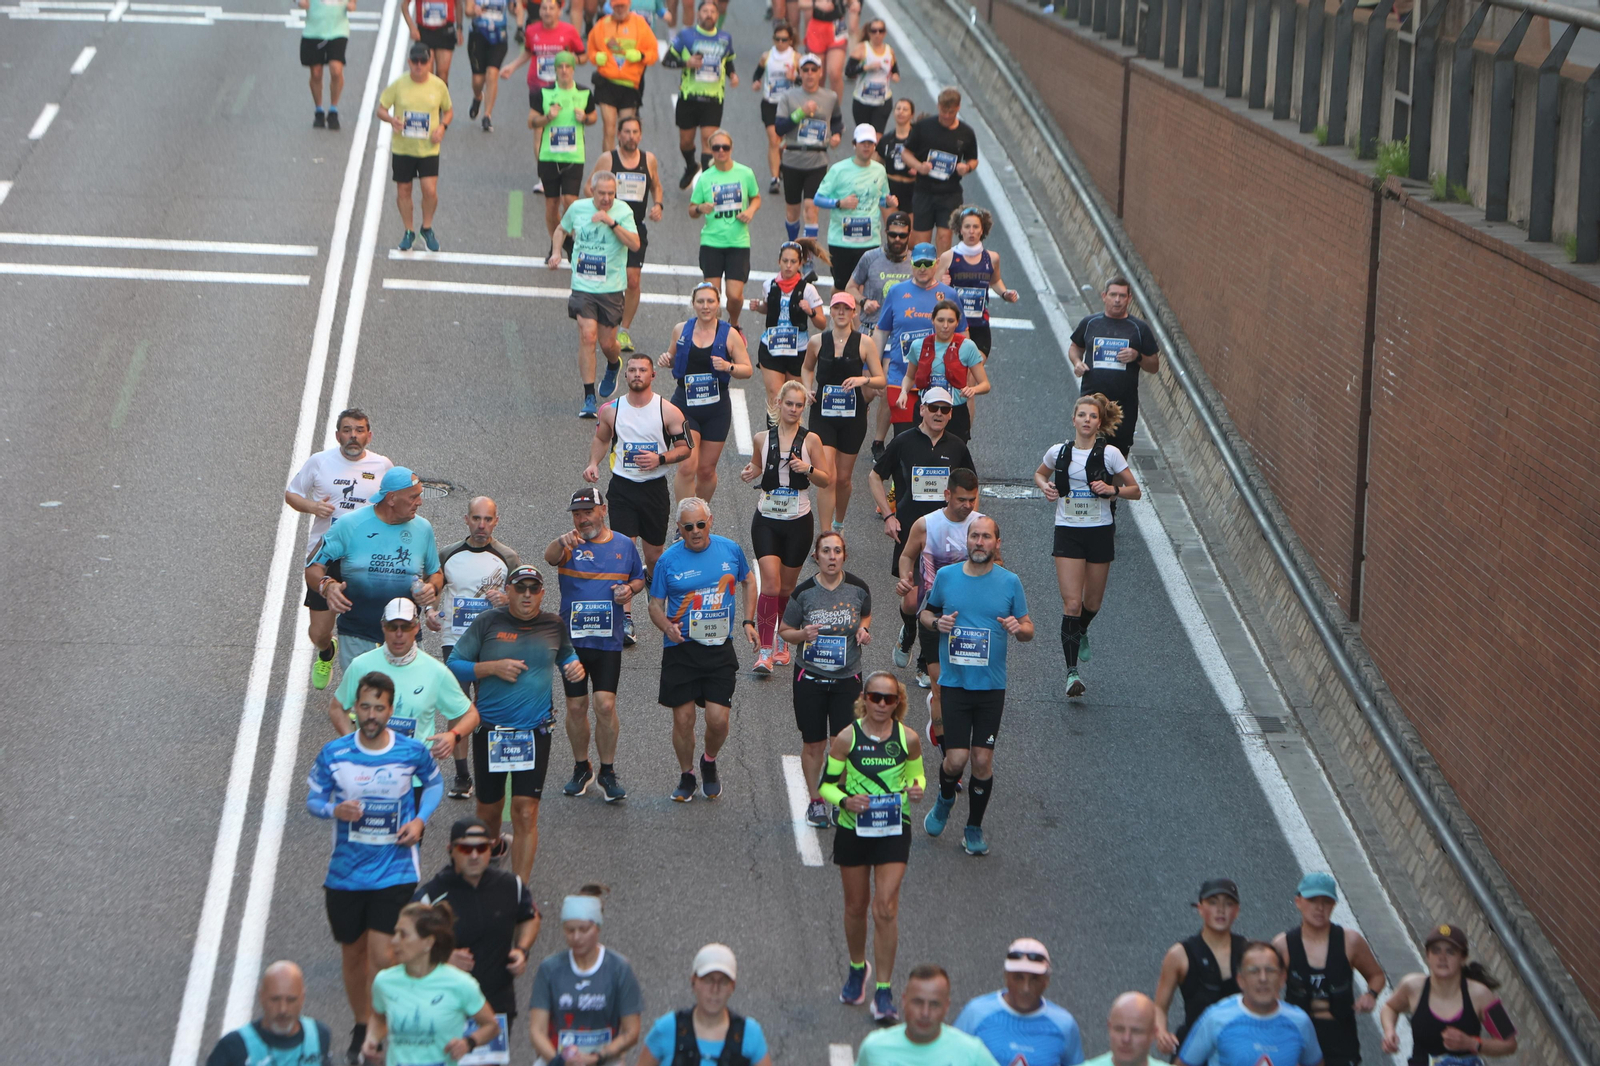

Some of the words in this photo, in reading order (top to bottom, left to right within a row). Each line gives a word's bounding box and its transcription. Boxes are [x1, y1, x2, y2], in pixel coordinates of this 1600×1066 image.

[371, 553, 392, 561] GOLF
[368, 566, 407, 575] DAURADA
[702, 592, 726, 606] FAST
[955, 650, 981, 658] ALEXANDRE
[387, 719, 412, 728] ZURICH
[861, 757, 897, 766] COSTANZA
[872, 797, 896, 805] ZURICH
[367, 803, 396, 811] ZURICH
[871, 811, 889, 819] 13071
